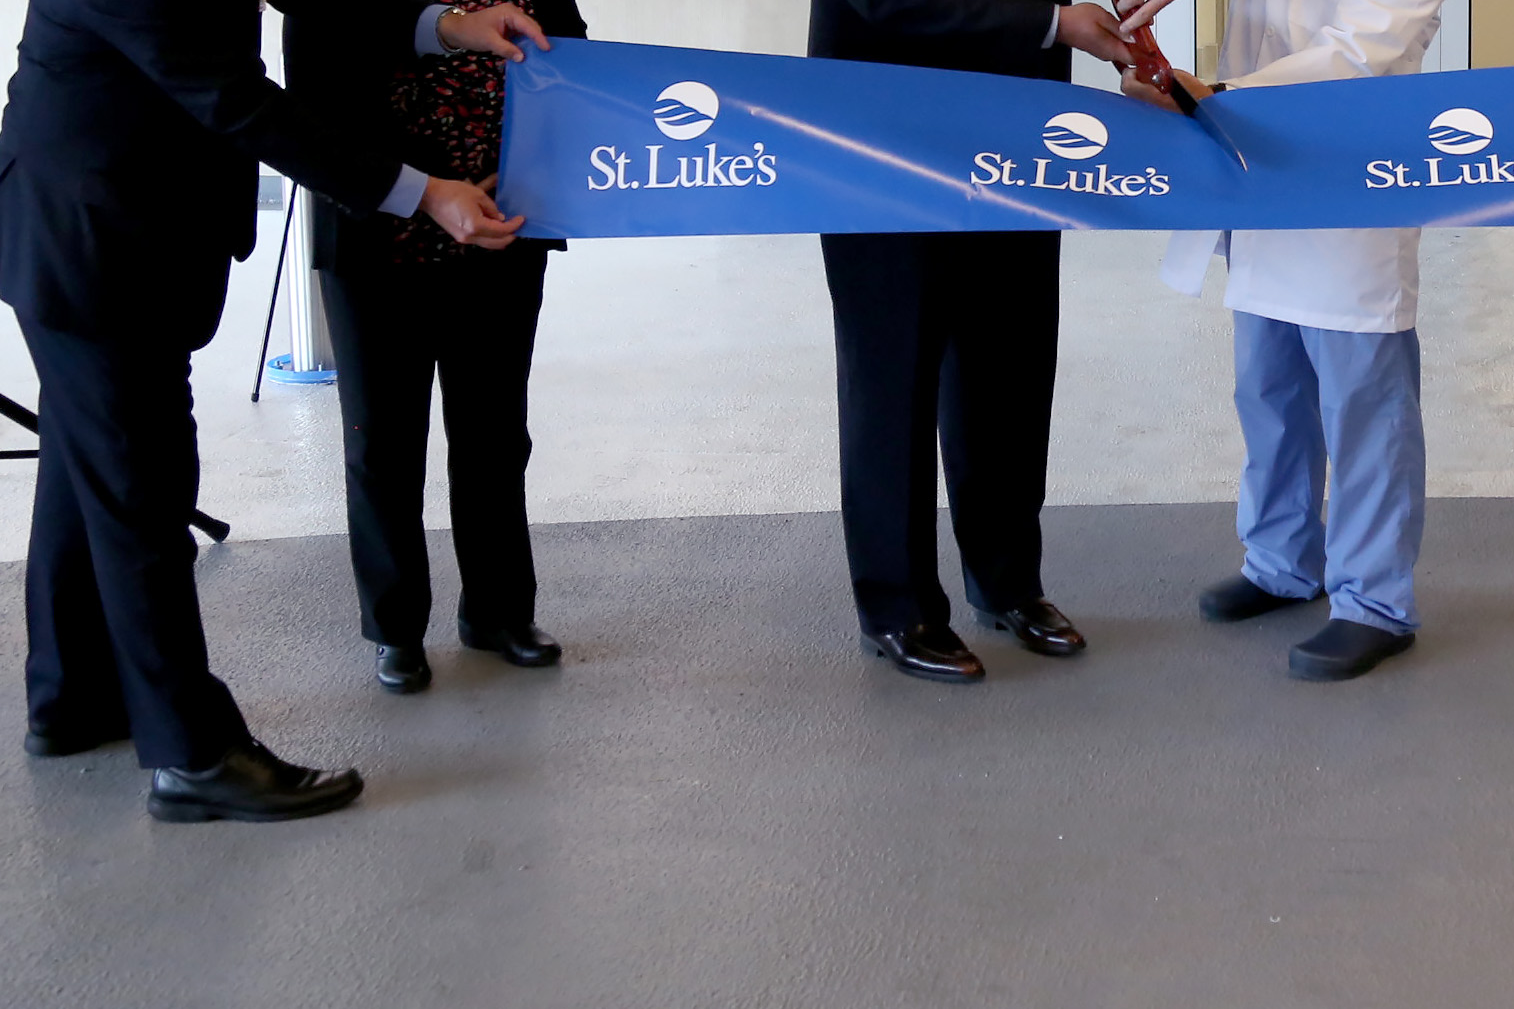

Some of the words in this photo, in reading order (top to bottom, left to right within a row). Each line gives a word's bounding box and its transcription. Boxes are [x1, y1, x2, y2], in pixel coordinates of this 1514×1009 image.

[588, 145, 640, 190] St.
[643, 142, 777, 189] Luke's
[970, 152, 1025, 186] St.
[1029, 158, 1170, 197] Luke's
[1366, 159, 1421, 189] St.
